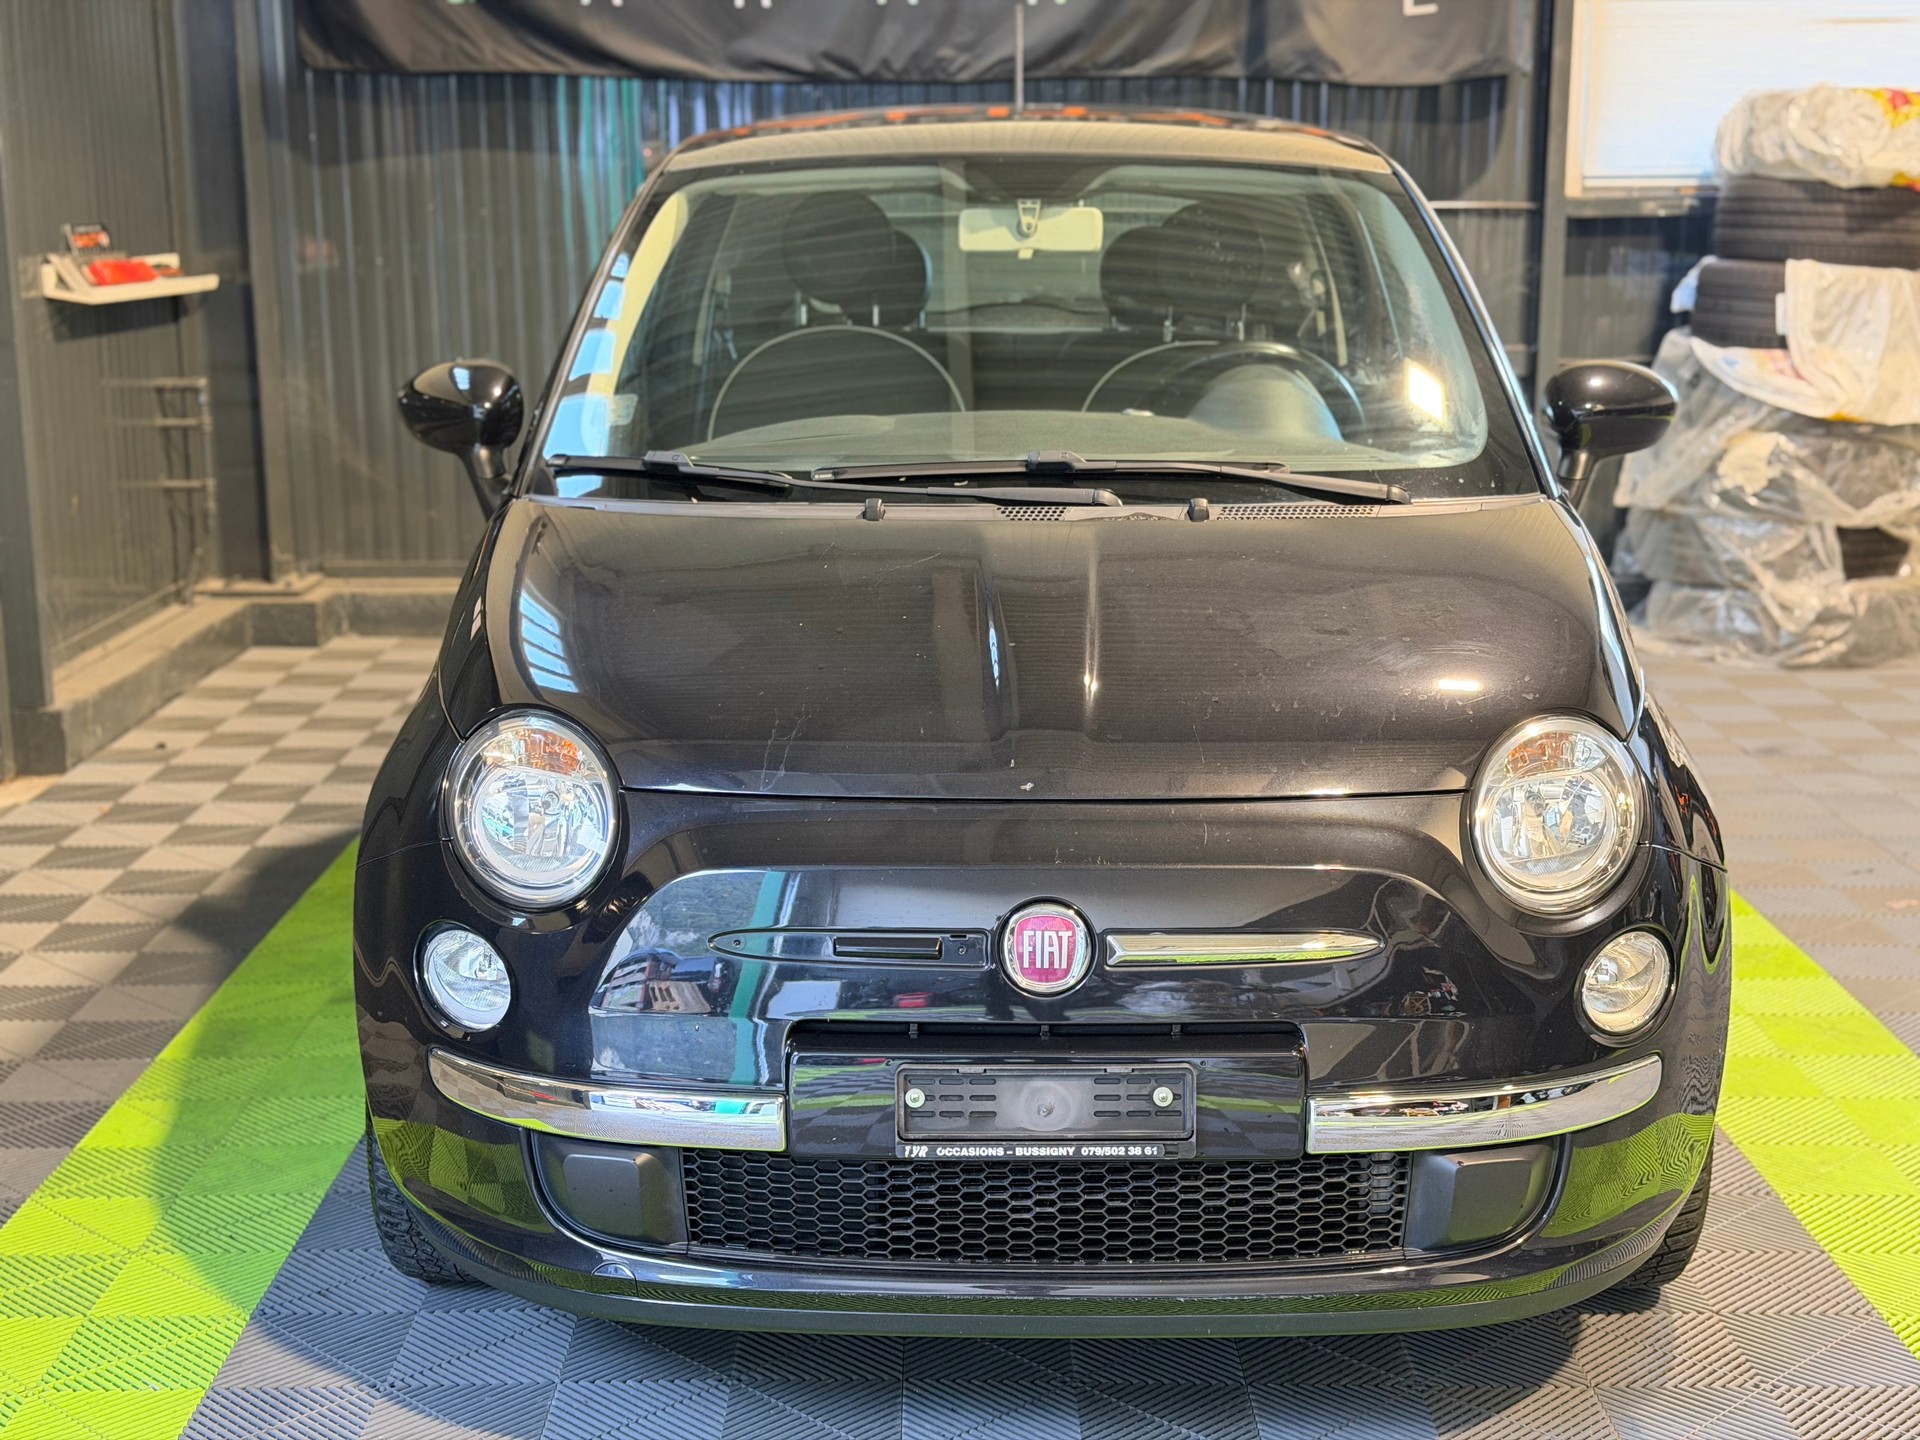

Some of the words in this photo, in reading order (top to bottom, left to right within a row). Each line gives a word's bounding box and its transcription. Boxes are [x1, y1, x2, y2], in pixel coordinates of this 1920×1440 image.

[1023, 930, 1072, 969] FIAT
[936, 1146, 1005, 1156] OCCASIONS
[1015, 1146, 1075, 1156] BUSSIGNY
[1081, 1146, 1125, 1157] 079/502
[1128, 1146, 1142, 1156] 38
[1144, 1146, 1158, 1155] 61
